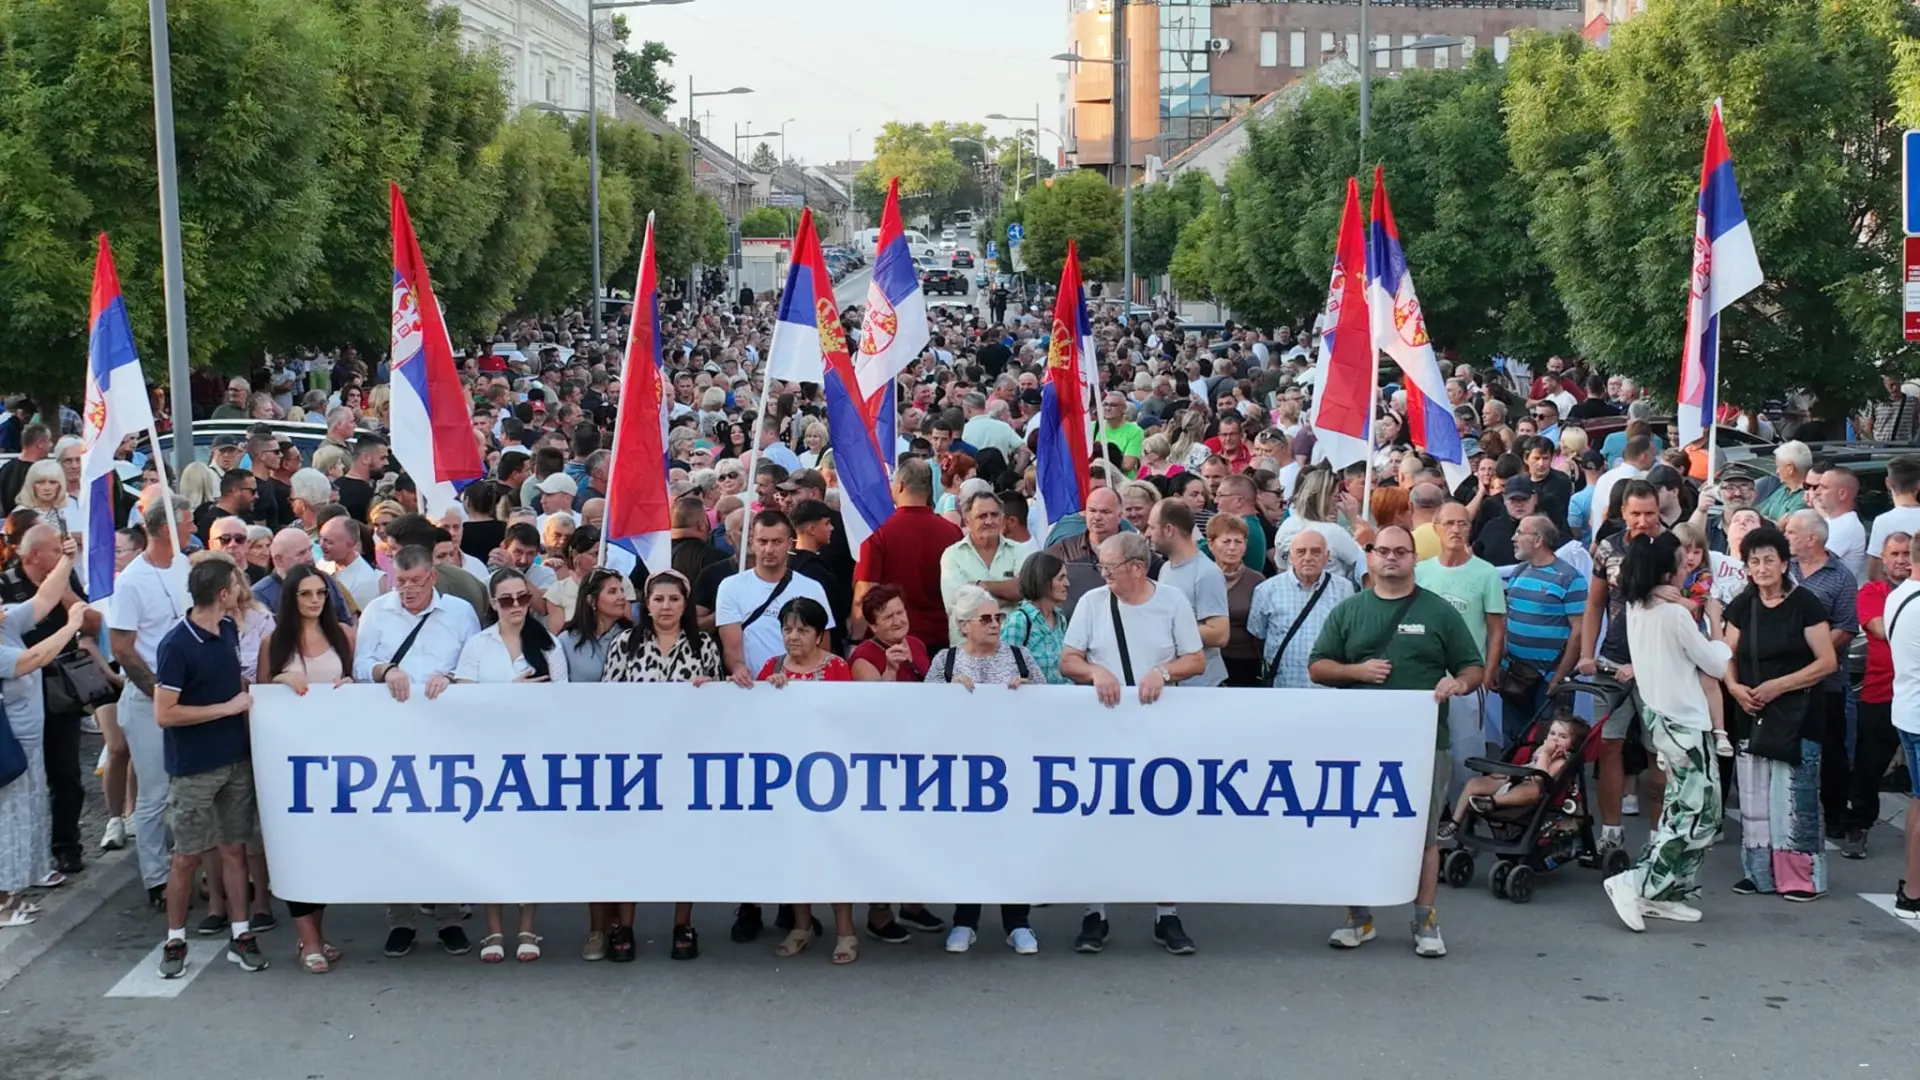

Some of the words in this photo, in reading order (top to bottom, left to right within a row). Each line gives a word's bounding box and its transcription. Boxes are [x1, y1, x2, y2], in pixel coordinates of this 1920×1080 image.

[1717, 560, 1746, 581] DES
[287, 753, 663, 823] ГРАЂАНИ
[687, 752, 1009, 812] ПРОТИВ
[1032, 756, 1417, 829] БЛОКАДА
